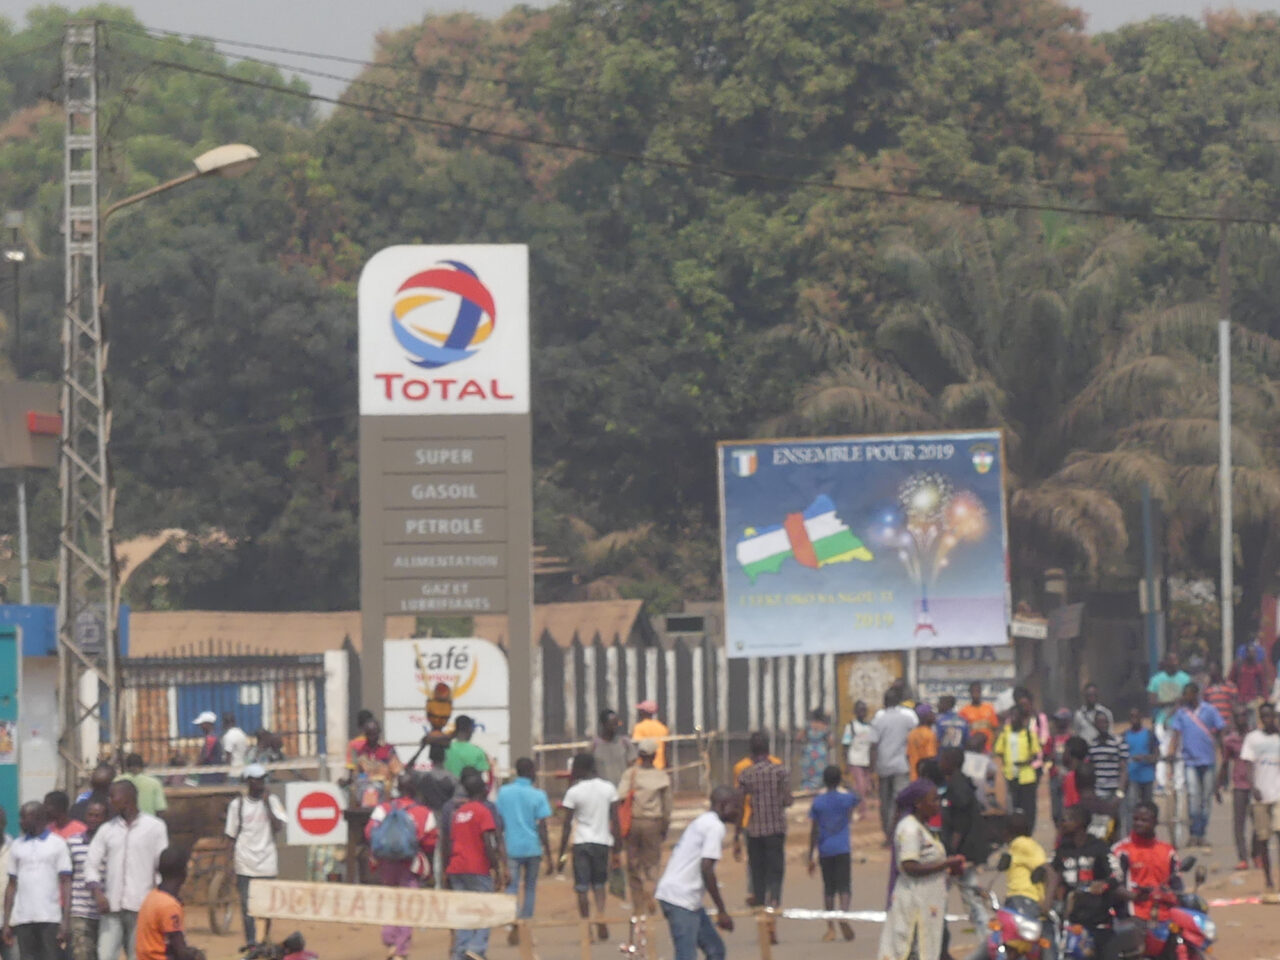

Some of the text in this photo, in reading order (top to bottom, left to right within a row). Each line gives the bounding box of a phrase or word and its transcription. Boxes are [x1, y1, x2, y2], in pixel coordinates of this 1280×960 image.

[374, 373, 515, 401] TOTAL
[415, 448, 473, 465] SUPER
[772, 443, 955, 465] ENSEMBLE POUR 2019
[411, 483, 478, 500] GASOIL
[405, 518, 484, 534] PETROLE
[393, 555, 499, 568] ALIMENTATION
[421, 583, 450, 596] GAZ
[400, 598, 491, 611] LUBRIFIANTS
[415, 644, 470, 670] café
[268, 884, 448, 921] DEVIATION
